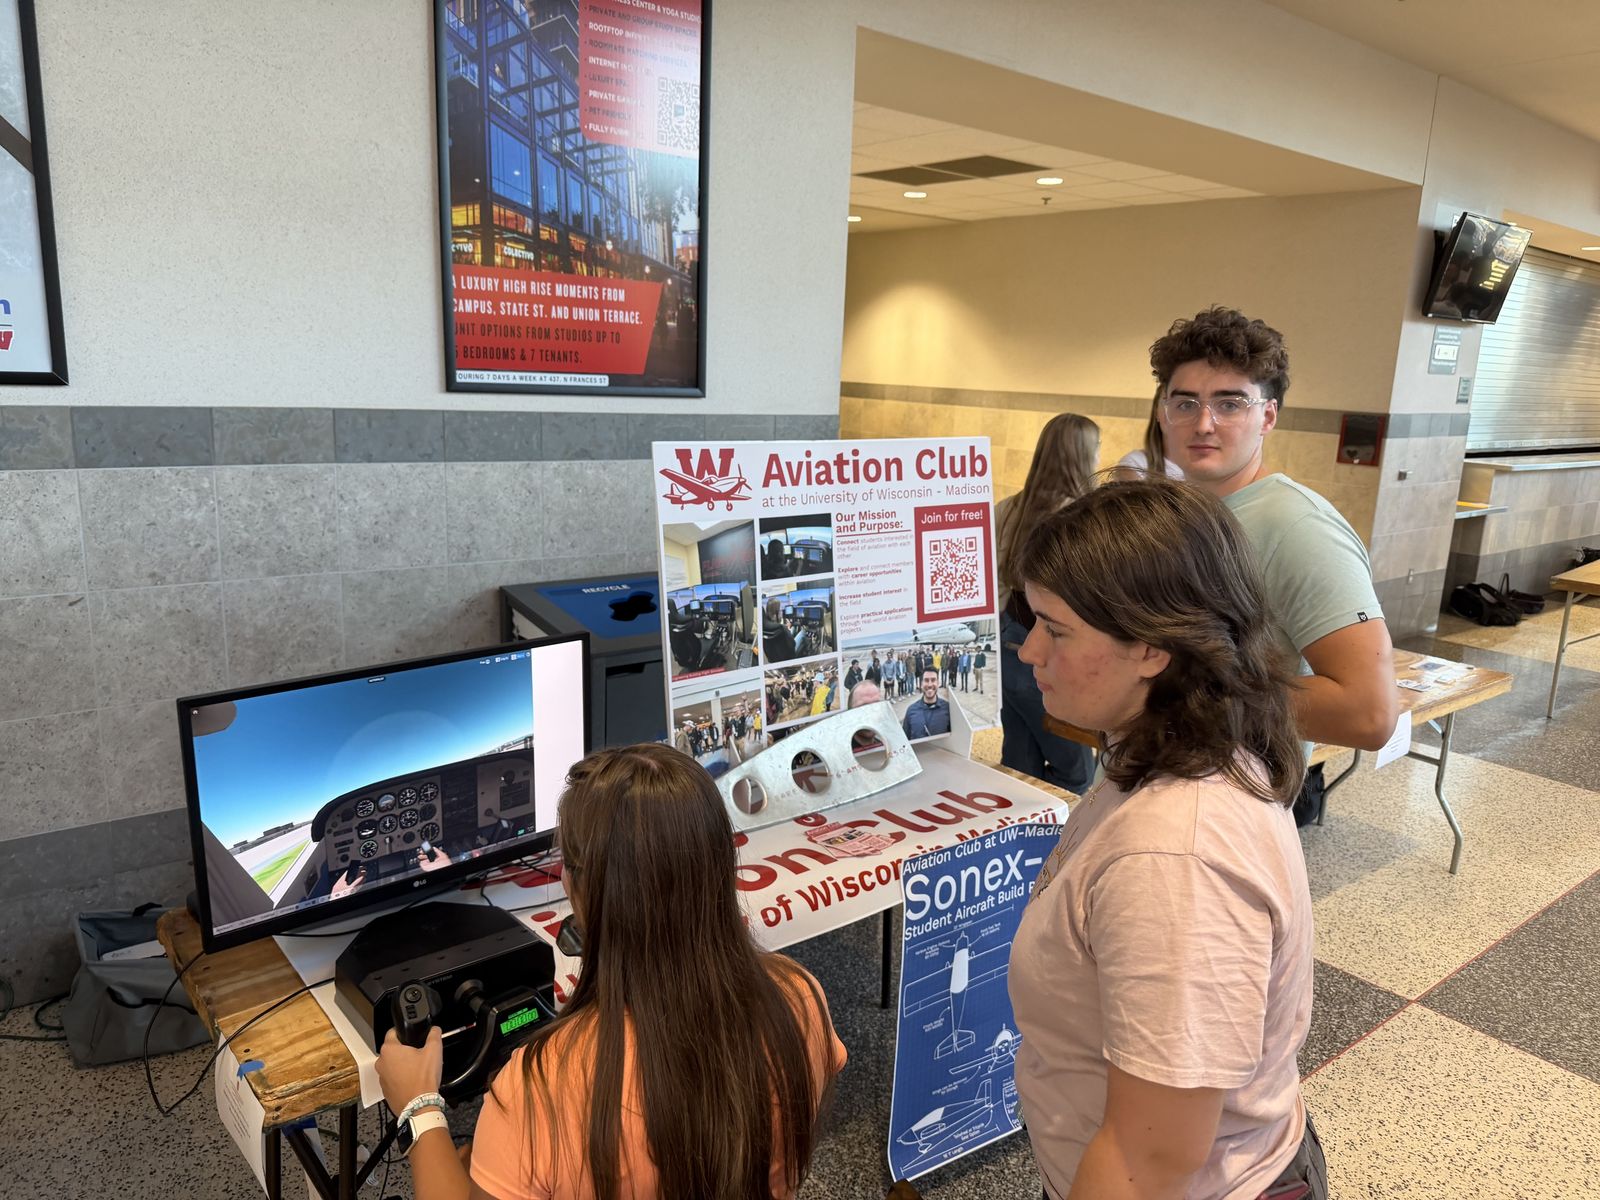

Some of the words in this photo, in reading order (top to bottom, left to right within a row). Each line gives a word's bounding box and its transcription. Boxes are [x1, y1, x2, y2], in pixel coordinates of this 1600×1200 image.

[589, 5, 616, 18] PRIVATE
[618, 12, 631, 21] AND
[632, 16, 654, 26] GROUP
[662, 7, 679, 17] YOGA
[589, 56, 620, 69] INTERNET
[589, 90, 615, 102] PRIVATE
[589, 123, 608, 133] FULLY
[504, 246, 534, 260] COLECTIVO
[461, 276, 499, 291] LUXURY
[504, 278, 527, 293] HIGH
[531, 280, 552, 296] RISE
[556, 283, 599, 300] MOMENTS
[602, 287, 625, 302] FROM
[452, 298, 496, 315] CAMPUS,
[500, 301, 529, 317] STATE
[533, 304, 548, 318] ST.
[551, 305, 569, 320] AND
[573, 308, 600, 321] UNION
[603, 310, 643, 325] TERRACE.
[480, 324, 522, 338] OPTIONS
[526, 326, 550, 340] FROM
[555, 328, 592, 341] STUDIOS
[596, 330, 607, 342] UP
[610, 331, 621, 343] TO
[463, 345, 515, 361] BEDROOMS
[520, 349, 527, 360] &
[530, 349, 535, 362] 7
[540, 349, 583, 364] TENANTS.
[456, 373, 484, 381] OURING
[762, 450, 903, 488] Aviation
[916, 445, 988, 480] Club
[762, 495, 775, 508] at
[778, 493, 796, 506] the
[801, 488, 857, 505] University
[861, 489, 873, 502] of
[876, 486, 932, 500] Wisconsin
[946, 484, 990, 496] Madison
[836, 512, 855, 522] Our
[859, 509, 896, 520] Mission
[921, 512, 942, 524] Join
[944, 511, 958, 522] for
[961, 510, 983, 520] free!
[836, 522, 856, 533] and
[860, 521, 903, 533] Purpose:
[582, 584, 630, 594] RECYCLE
[902, 850, 950, 876] Aviation
[955, 840, 981, 858] Club
[985, 835, 996, 849] at
[1000, 826, 1063, 844] UW-Madis
[760, 894, 793, 928] of
[904, 912, 952, 940] Student
[955, 895, 995, 921] Aircraft
[998, 883, 1024, 904] Build
